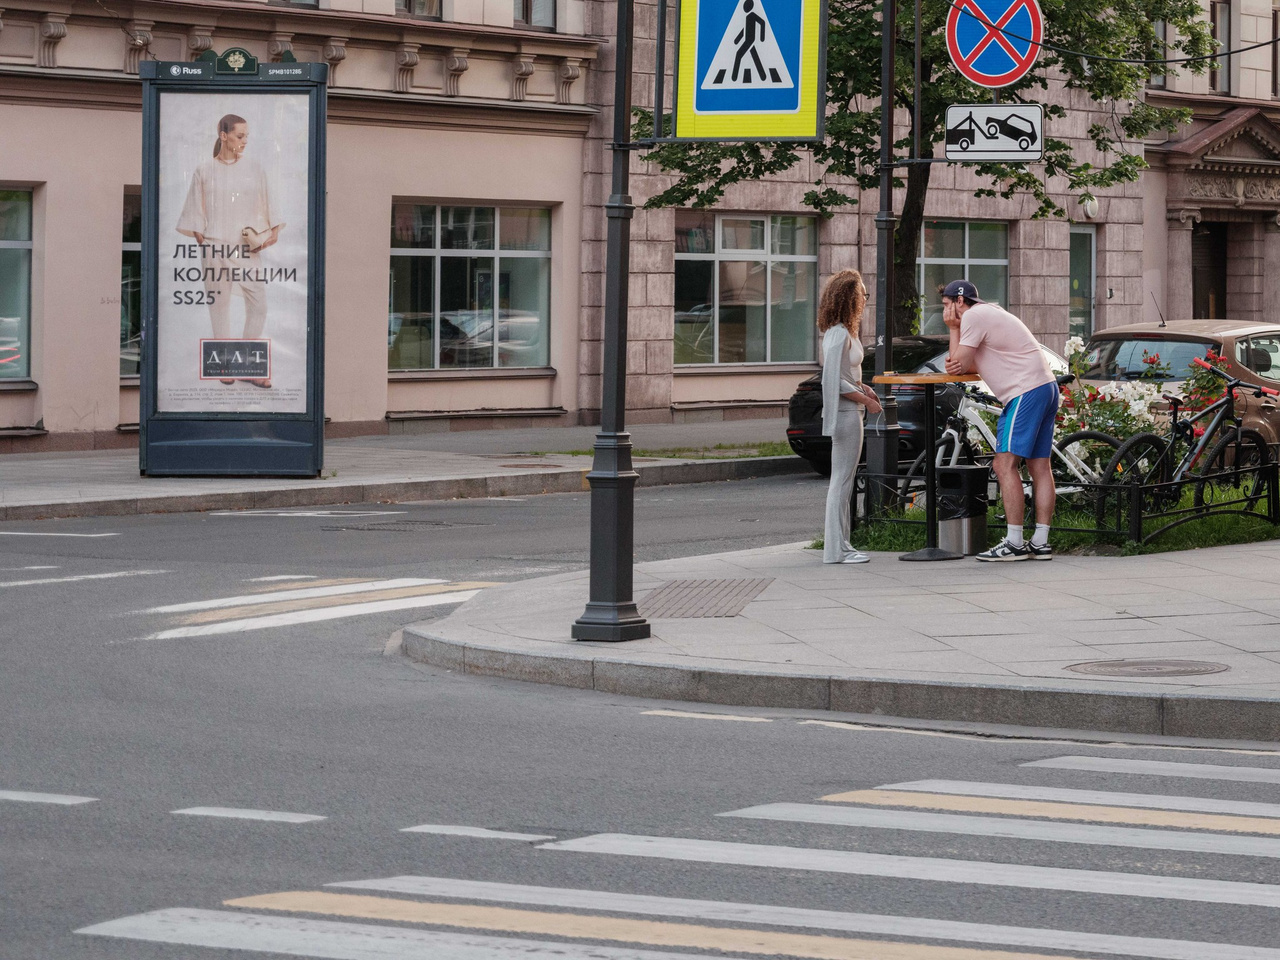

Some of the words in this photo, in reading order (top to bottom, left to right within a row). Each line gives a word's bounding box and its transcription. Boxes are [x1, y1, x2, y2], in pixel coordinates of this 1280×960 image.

[182, 67, 202, 75] Russ
[173, 244, 251, 259] ЛЕТНИЕ
[174, 267, 297, 285] КОЛЛЕКЦИИ
[957, 286, 964, 295] 3
